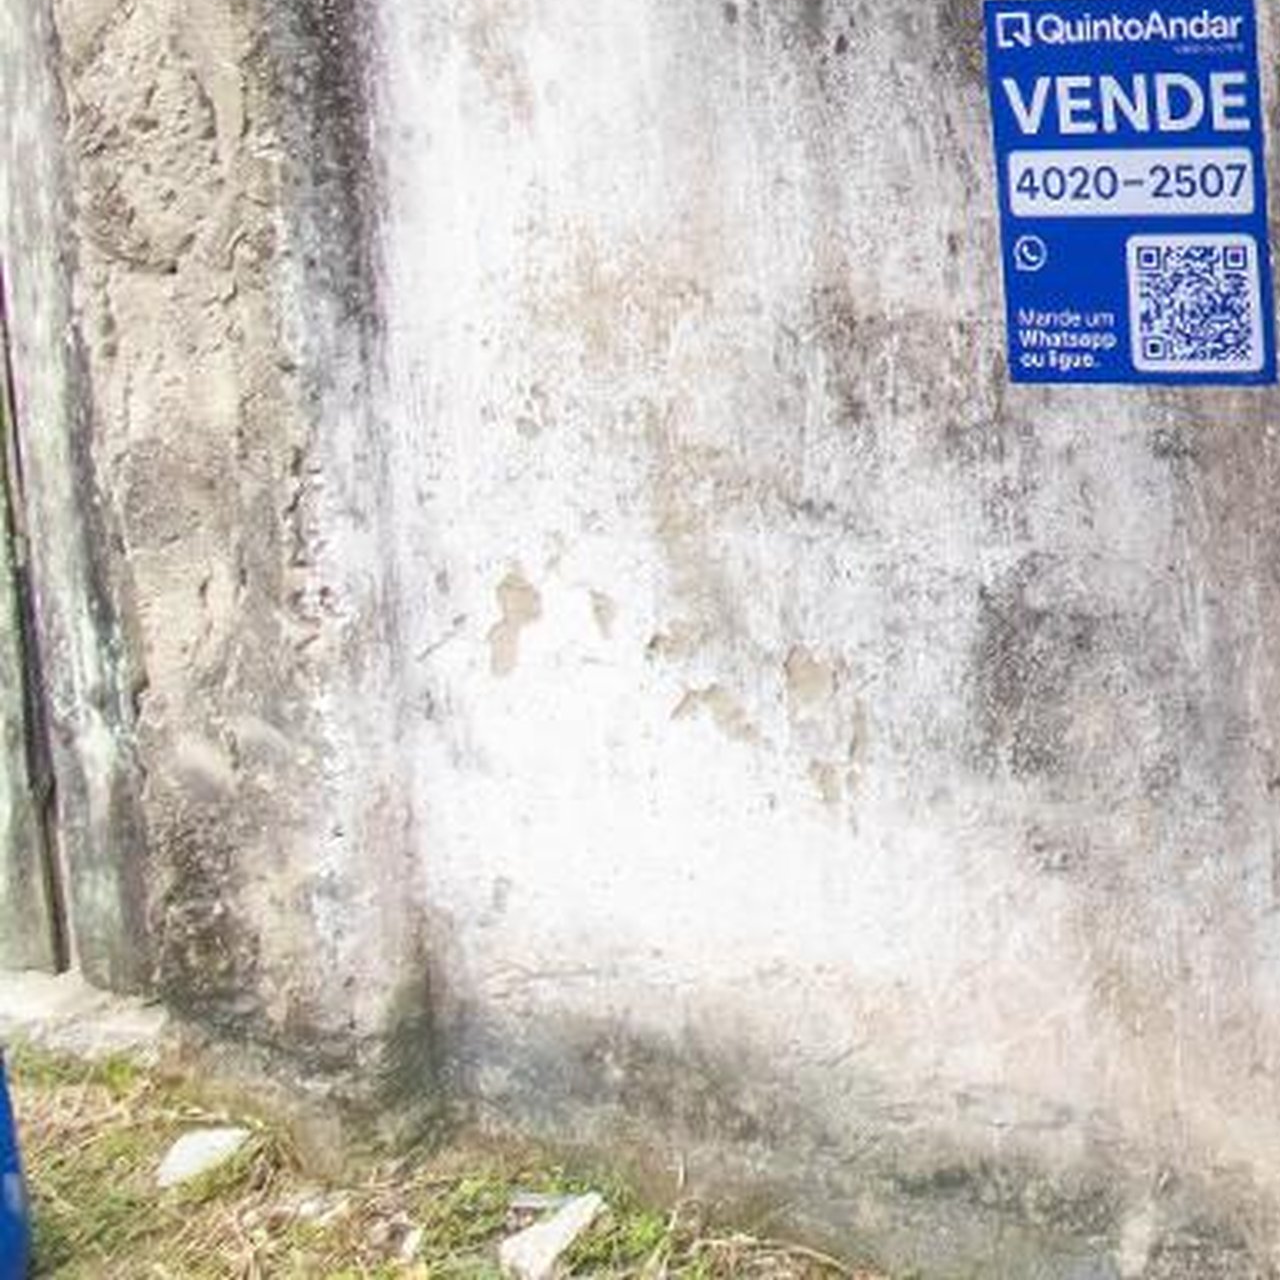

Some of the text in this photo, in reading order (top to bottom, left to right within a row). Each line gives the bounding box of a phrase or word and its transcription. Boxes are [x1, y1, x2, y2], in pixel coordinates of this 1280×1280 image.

[1036, 10, 1243, 45] QuintoAndar
[1002, 72, 1251, 135] VENDE
[1016, 163, 1248, 201] 4020-2507
[1018, 307, 1115, 328] Mande um
[1019, 353, 1044, 368] ou
